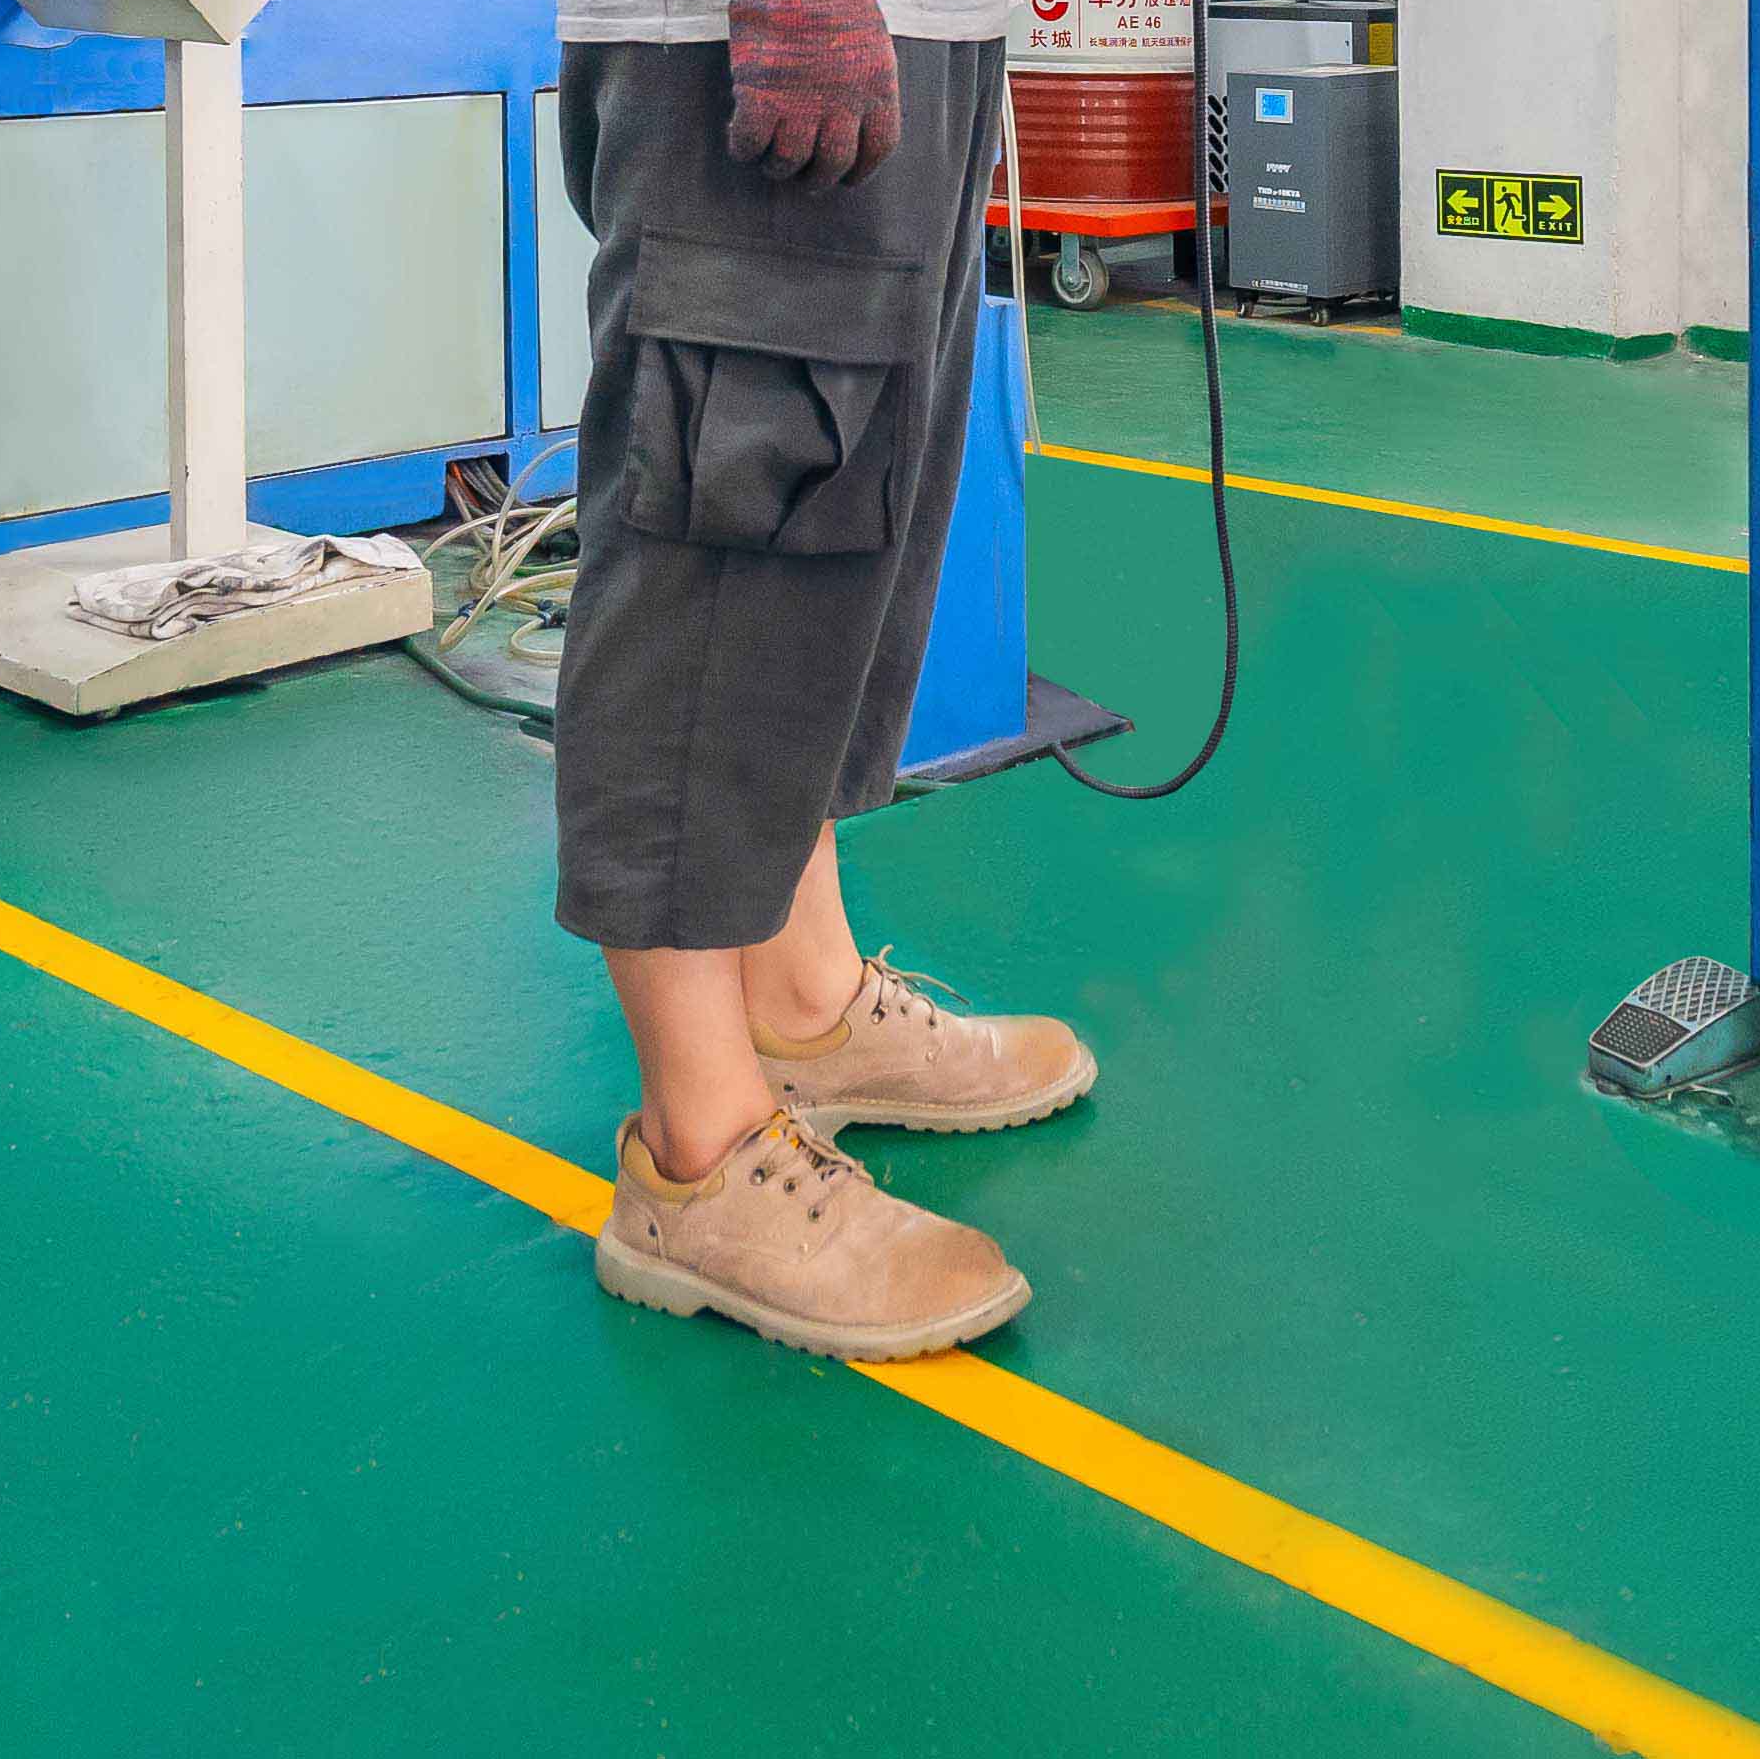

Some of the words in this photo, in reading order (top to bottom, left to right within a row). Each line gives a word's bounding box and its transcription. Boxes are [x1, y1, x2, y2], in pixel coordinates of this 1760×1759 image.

[1117, 15, 1139, 29] AE
[1145, 15, 1161, 29] 46
[1029, 28, 1073, 49] 长城
[1446, 215, 1480, 226] 安全出口
[1538, 220, 1573, 232] EXIT
